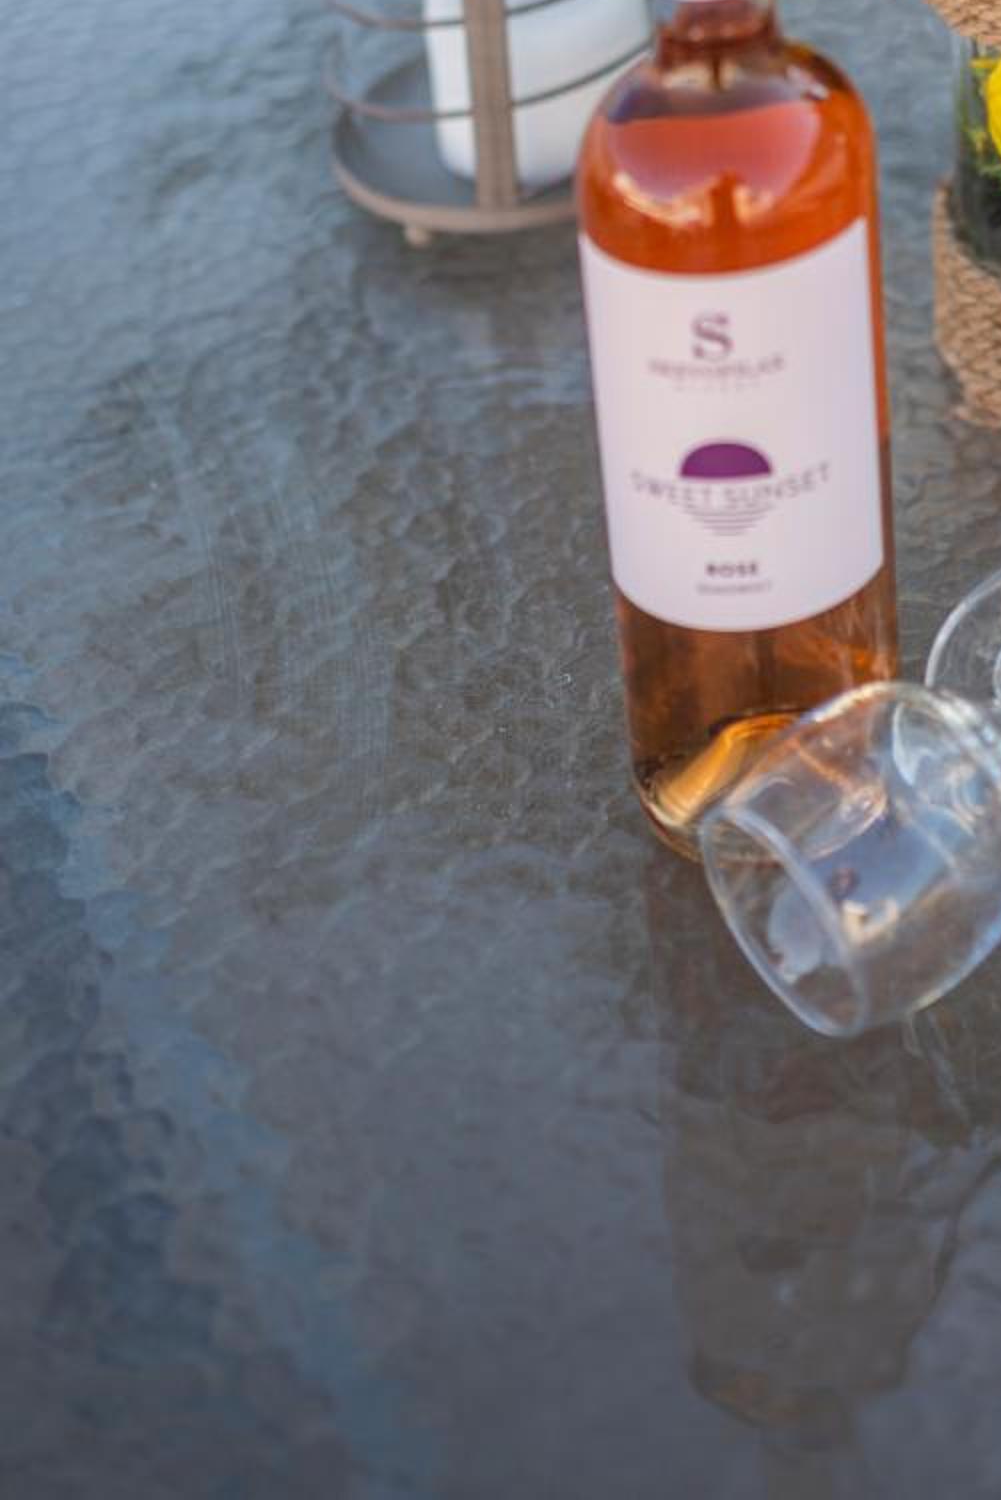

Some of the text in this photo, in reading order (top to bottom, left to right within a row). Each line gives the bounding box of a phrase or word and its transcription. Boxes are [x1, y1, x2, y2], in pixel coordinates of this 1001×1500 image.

[692, 312, 733, 361] S
[630, 461, 830, 509] SWEET SUNSET
